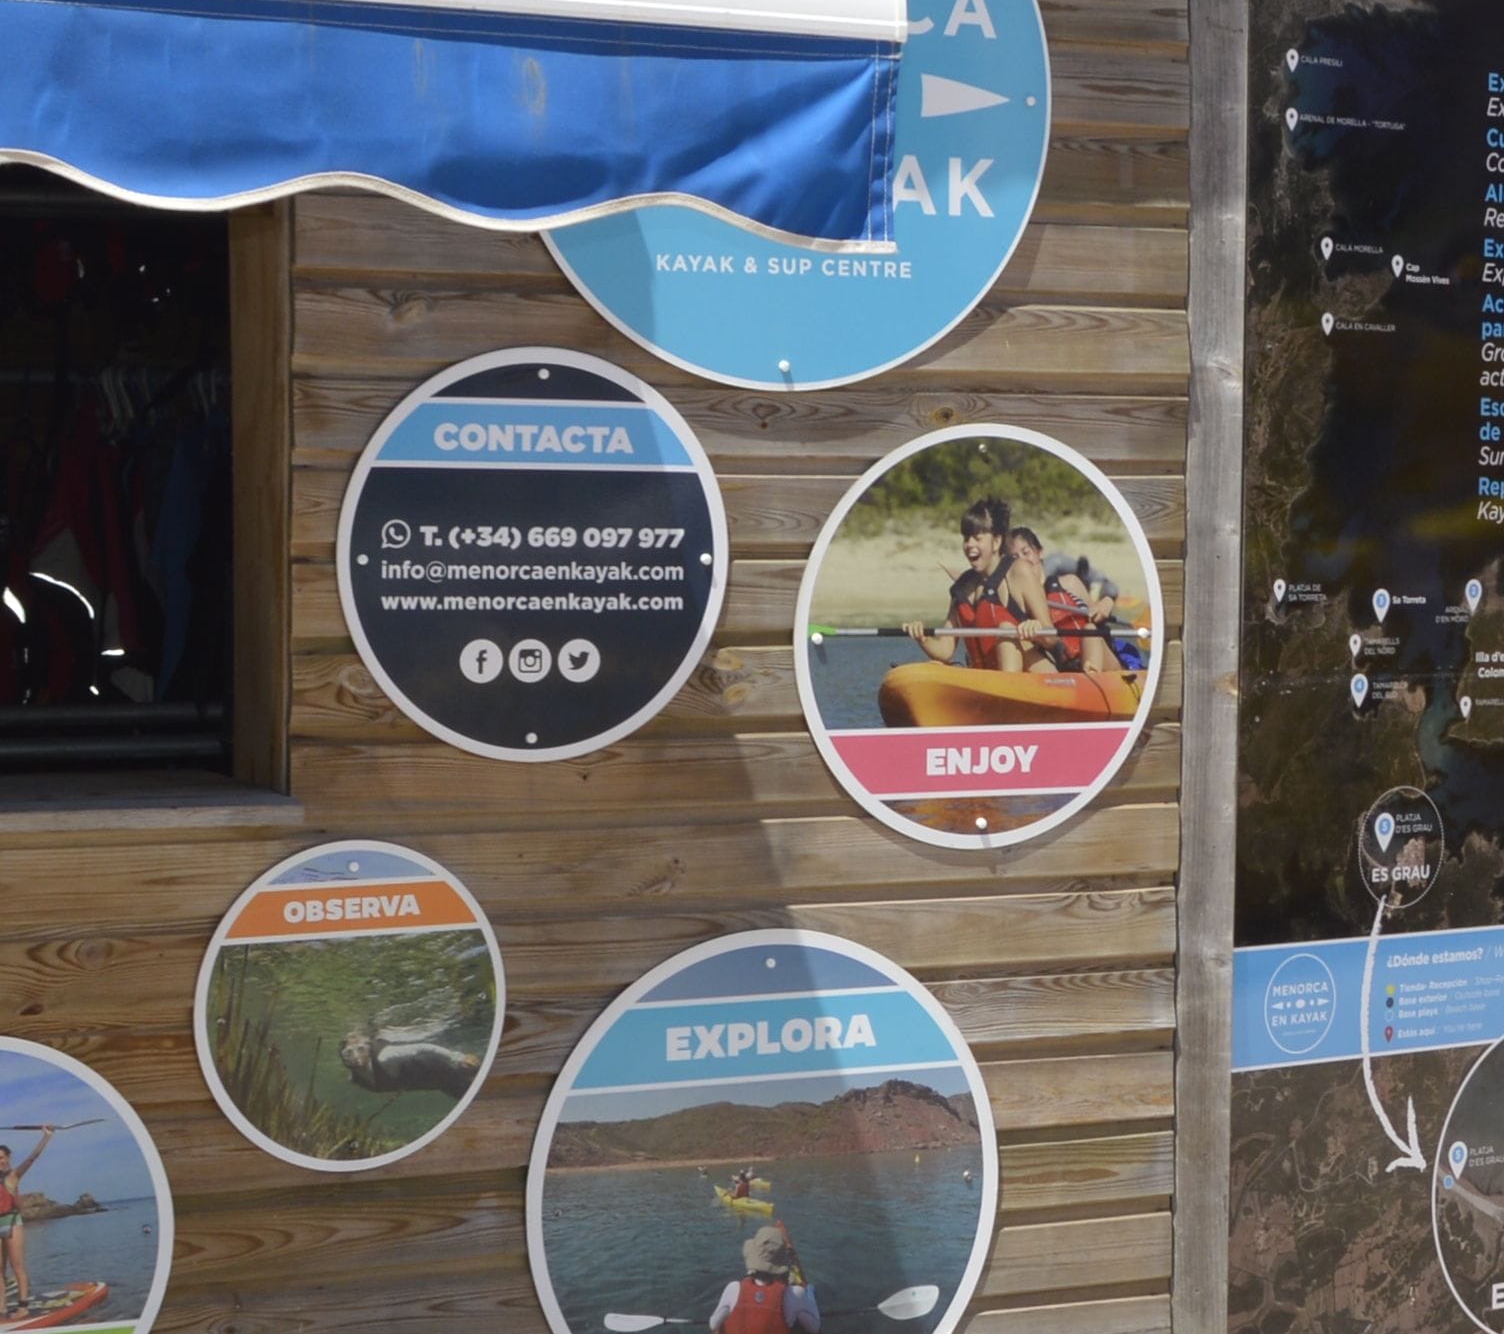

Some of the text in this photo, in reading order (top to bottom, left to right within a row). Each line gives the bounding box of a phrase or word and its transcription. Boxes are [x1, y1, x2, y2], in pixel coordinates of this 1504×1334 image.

[1300, 55, 1318, 65] CALA
[1335, 244, 1352, 252] CALA
[656, 254, 912, 279] KAYAK & SUP CENTRE
[1405, 263, 1420, 273] Cap
[1335, 322, 1353, 331] CALA
[1479, 422, 1500, 441] de
[434, 422, 634, 454] CONTACTA
[419, 525, 685, 549] T. (+34) 669 097 977
[381, 560, 684, 584] info@menorcaenkayak.com
[1288, 584, 1321, 593] PLATJA DE
[381, 592, 684, 613] www.menorcaenkayak.com
[1297, 594, 1327, 602] TORRETA
[1392, 596, 1426, 604] Sa Torreta
[1475, 652, 1490, 662] Illa
[926, 745, 1038, 776] ENJOY
[1396, 813, 1421, 822] PLATJA
[1396, 824, 1432, 833] D'ES GRAU
[1372, 864, 1431, 883] ES GRAU
[283, 894, 421, 923] OBSERVA
[1387, 952, 1430, 968] ¿Dónde
[1432, 948, 1484, 964] estamos?
[1273, 981, 1329, 997] MENORCA
[1399, 994, 1448, 1006] Base exterior
[1272, 1011, 1328, 1026] EN KAYAK
[1398, 1010, 1416, 1018] Base
[666, 1014, 877, 1061] EXPLORA
[1469, 1146, 1494, 1156] PLATJA
[1469, 1155, 1504, 1167] D'ES GRAU
